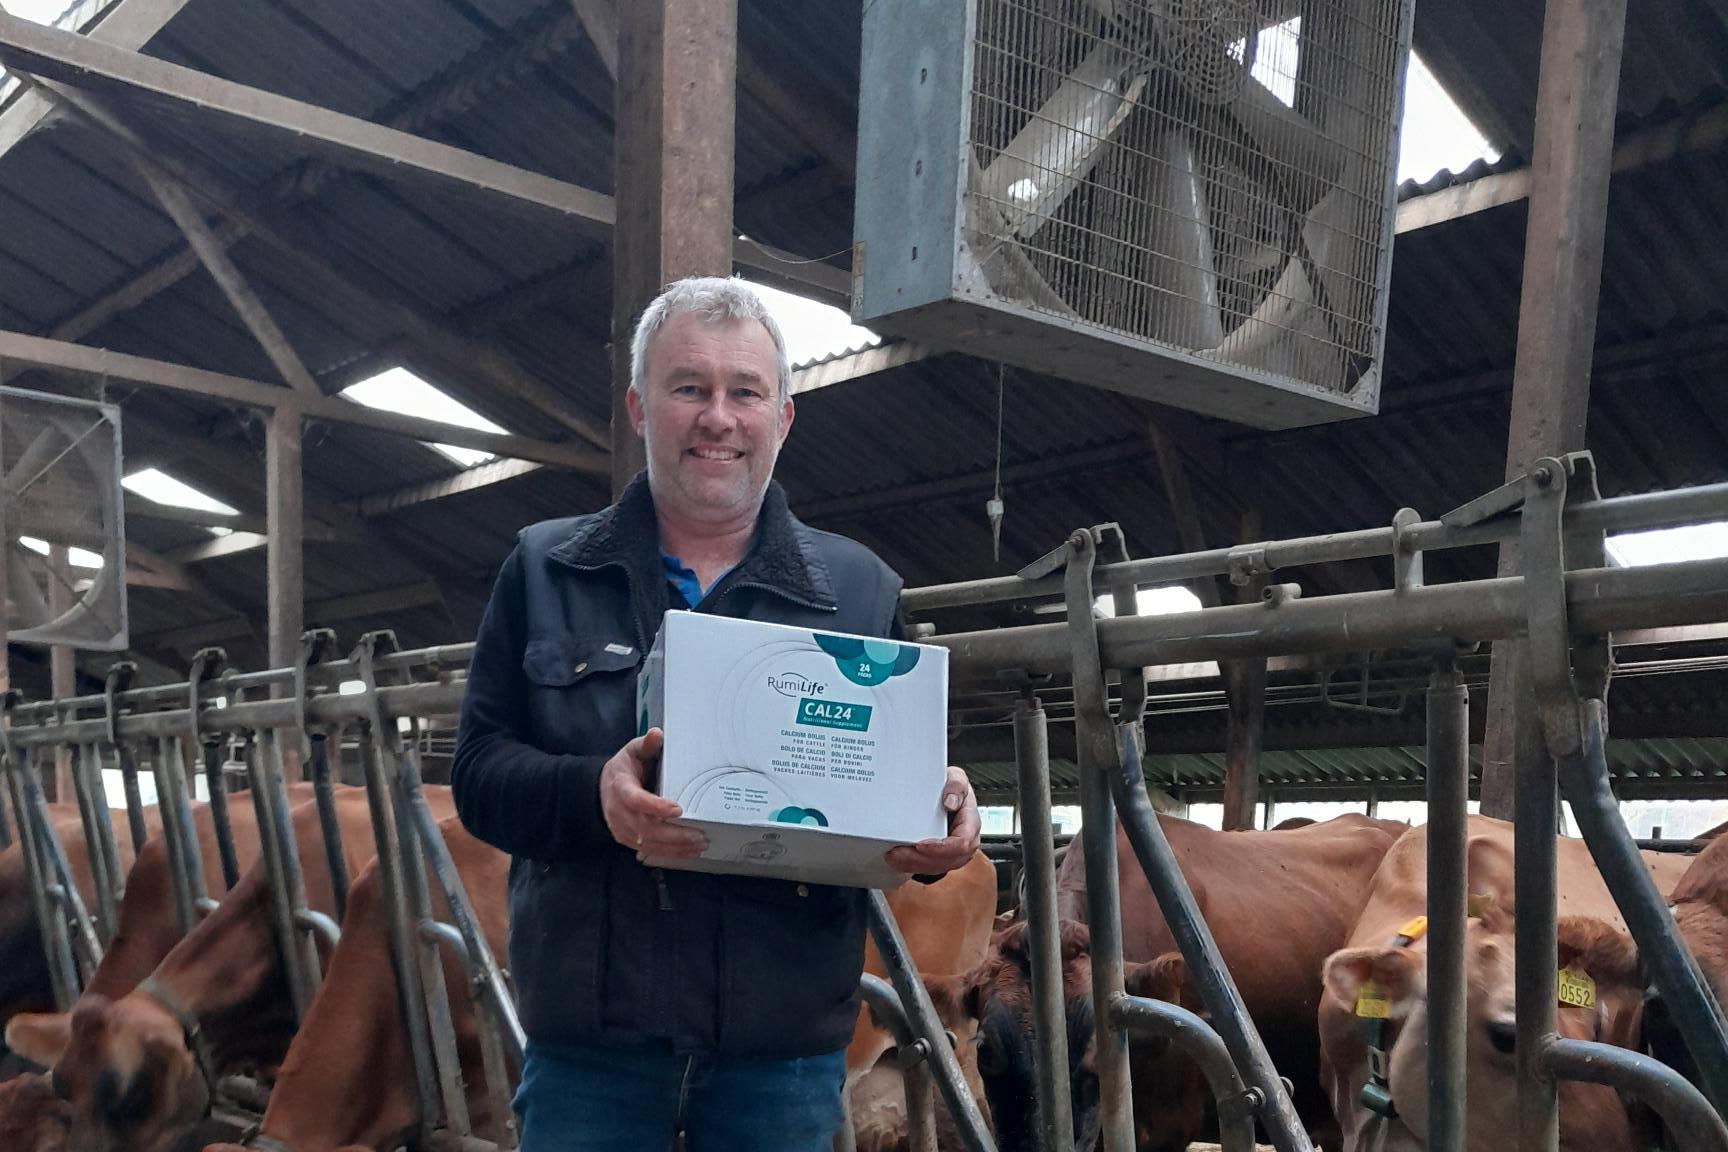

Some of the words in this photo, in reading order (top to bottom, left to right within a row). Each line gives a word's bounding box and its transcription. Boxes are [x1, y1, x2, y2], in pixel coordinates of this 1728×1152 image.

[859, 663, 871, 672] 24
[767, 675, 825, 696] RumiLife
[804, 702, 852, 721] CAL24
[780, 729, 806, 738] CALCIUM
[807, 733, 826, 741] BOLUS
[831, 736, 856, 744] CALCIUM
[805, 748, 826, 756] CALCIO
[852, 753, 873, 761] CALCIO
[772, 760, 791, 768] BOLUS
[800, 763, 826, 771] CALCIUM
[831, 766, 856, 775] CALCIUM
[1560, 983, 1591, 1007] 0552
